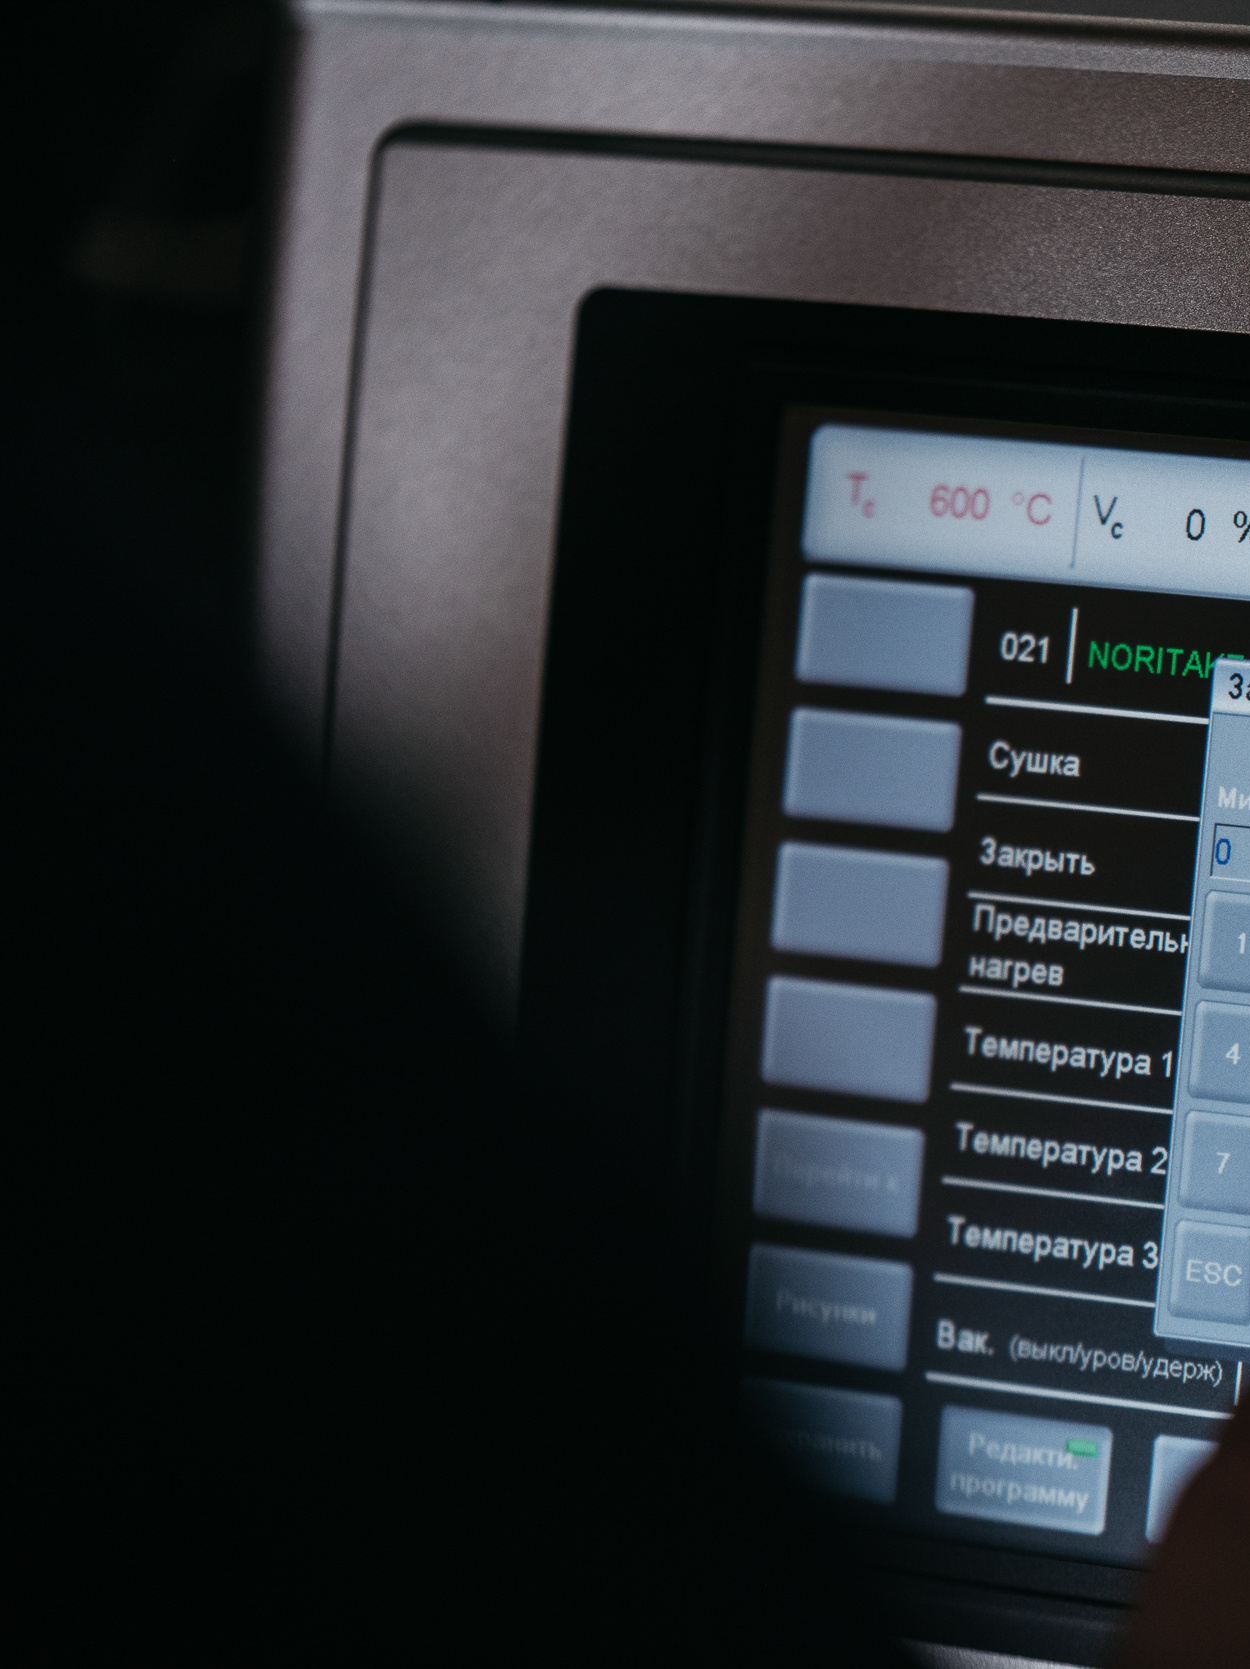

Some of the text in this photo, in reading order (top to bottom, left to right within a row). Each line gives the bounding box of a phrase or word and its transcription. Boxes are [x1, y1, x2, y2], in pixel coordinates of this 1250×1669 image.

[930, 484, 990, 520] 600
[1011, 489, 1052, 525] °C
[1186, 508, 1206, 541] 0
[1000, 630, 1051, 664] 021
[987, 738, 1081, 778] Сушка
[978, 834, 1096, 877] Закрыть
[1214, 838, 1232, 866] 0
[1236, 931, 1248, 956] 1
[966, 954, 1065, 989] нагрев
[962, 1024, 1174, 1080] Температура 1
[1224, 1042, 1242, 1067] 4
[954, 1119, 1169, 1176] Температура 2
[1215, 1151, 1232, 1176] 7
[945, 1212, 1160, 1271] Температура 3
[1186, 1259, 1243, 1287] ESC
[935, 1316, 1224, 1388] Вак. (выкл/уров/удерж)
[950, 1468, 1091, 1514] программу
